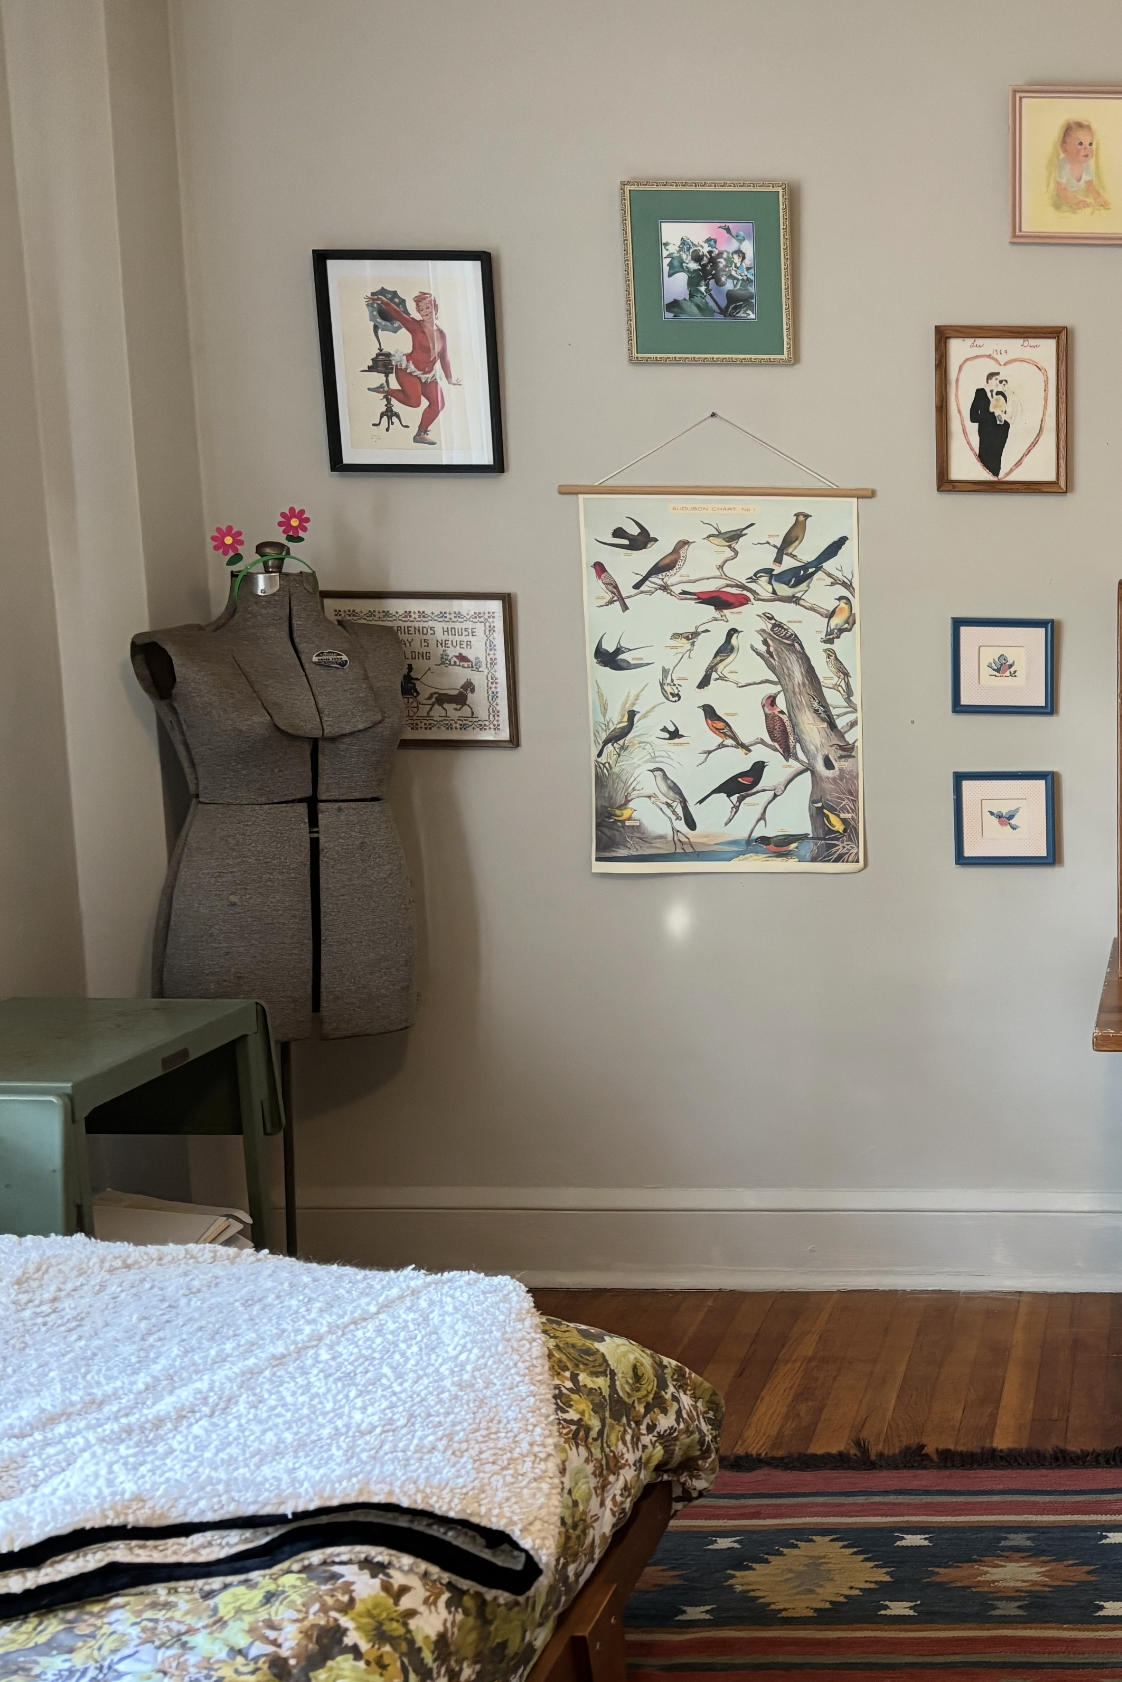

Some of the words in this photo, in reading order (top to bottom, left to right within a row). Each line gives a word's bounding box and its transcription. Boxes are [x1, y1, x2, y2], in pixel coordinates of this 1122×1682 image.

[396, 625, 436, 636] RIEND'S
[442, 626, 478, 637] HOUSE
[400, 638, 414, 648] AY
[420, 639, 430, 648] IS
[436, 639, 472, 650] NEVER
[403, 650, 431, 661] LONG
